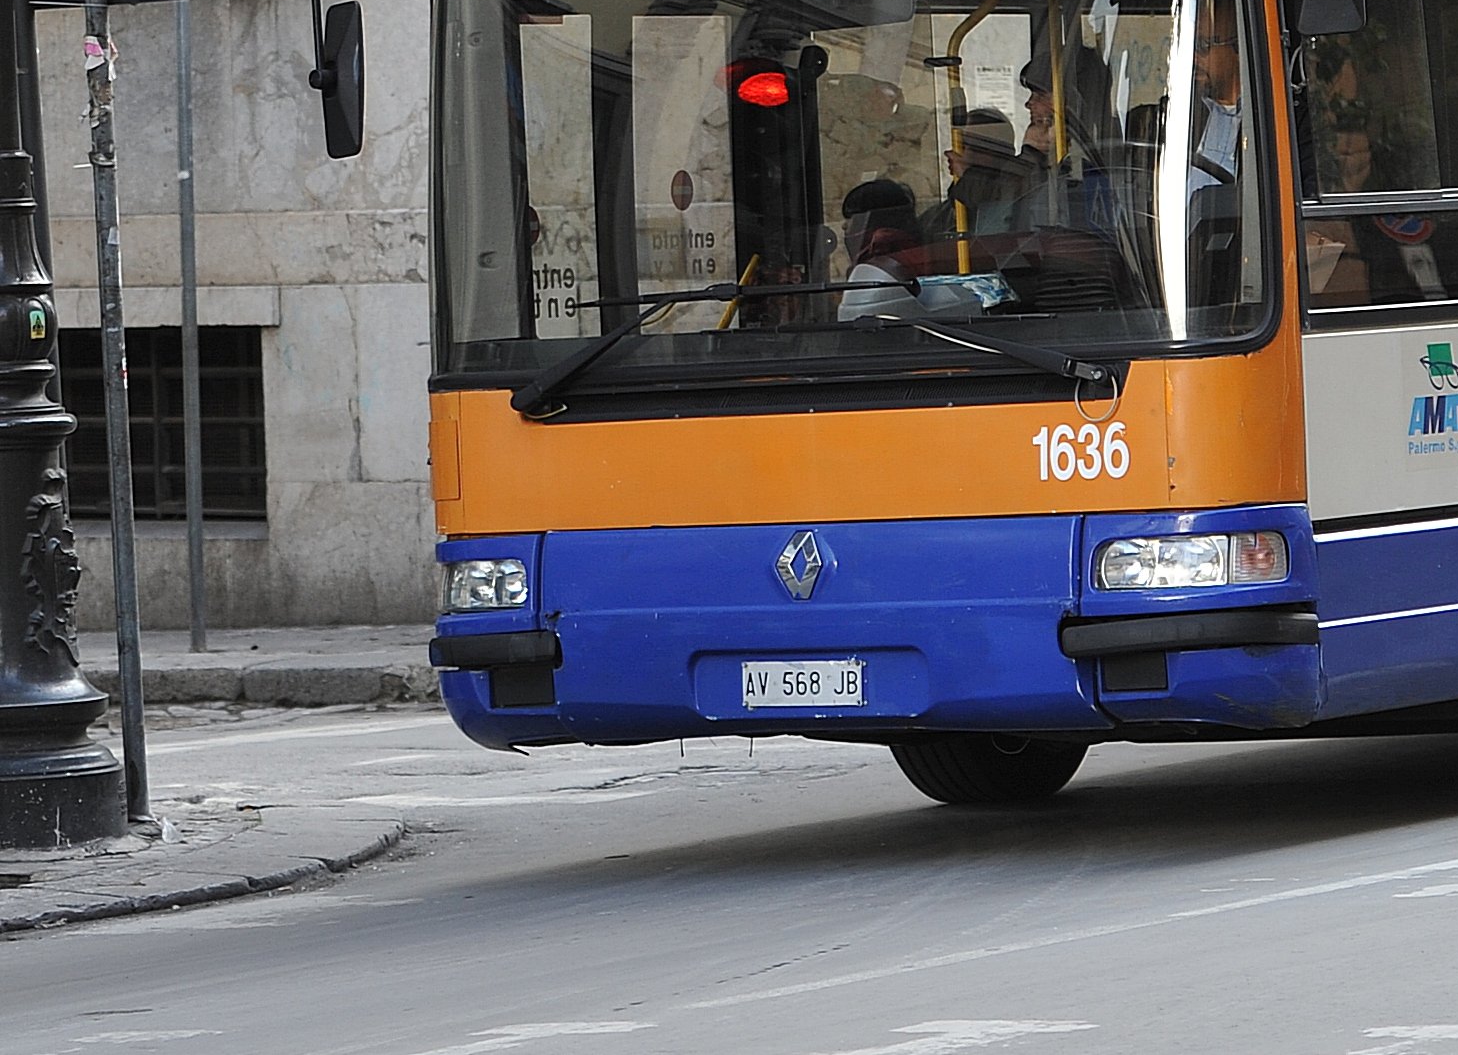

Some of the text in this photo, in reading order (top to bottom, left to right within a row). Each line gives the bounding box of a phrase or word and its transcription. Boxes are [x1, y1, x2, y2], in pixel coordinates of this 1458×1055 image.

[1031, 421, 1131, 482] 1636
[1408, 440, 1446, 455] Palermo
[746, 669, 859, 696] AV 568 JB
